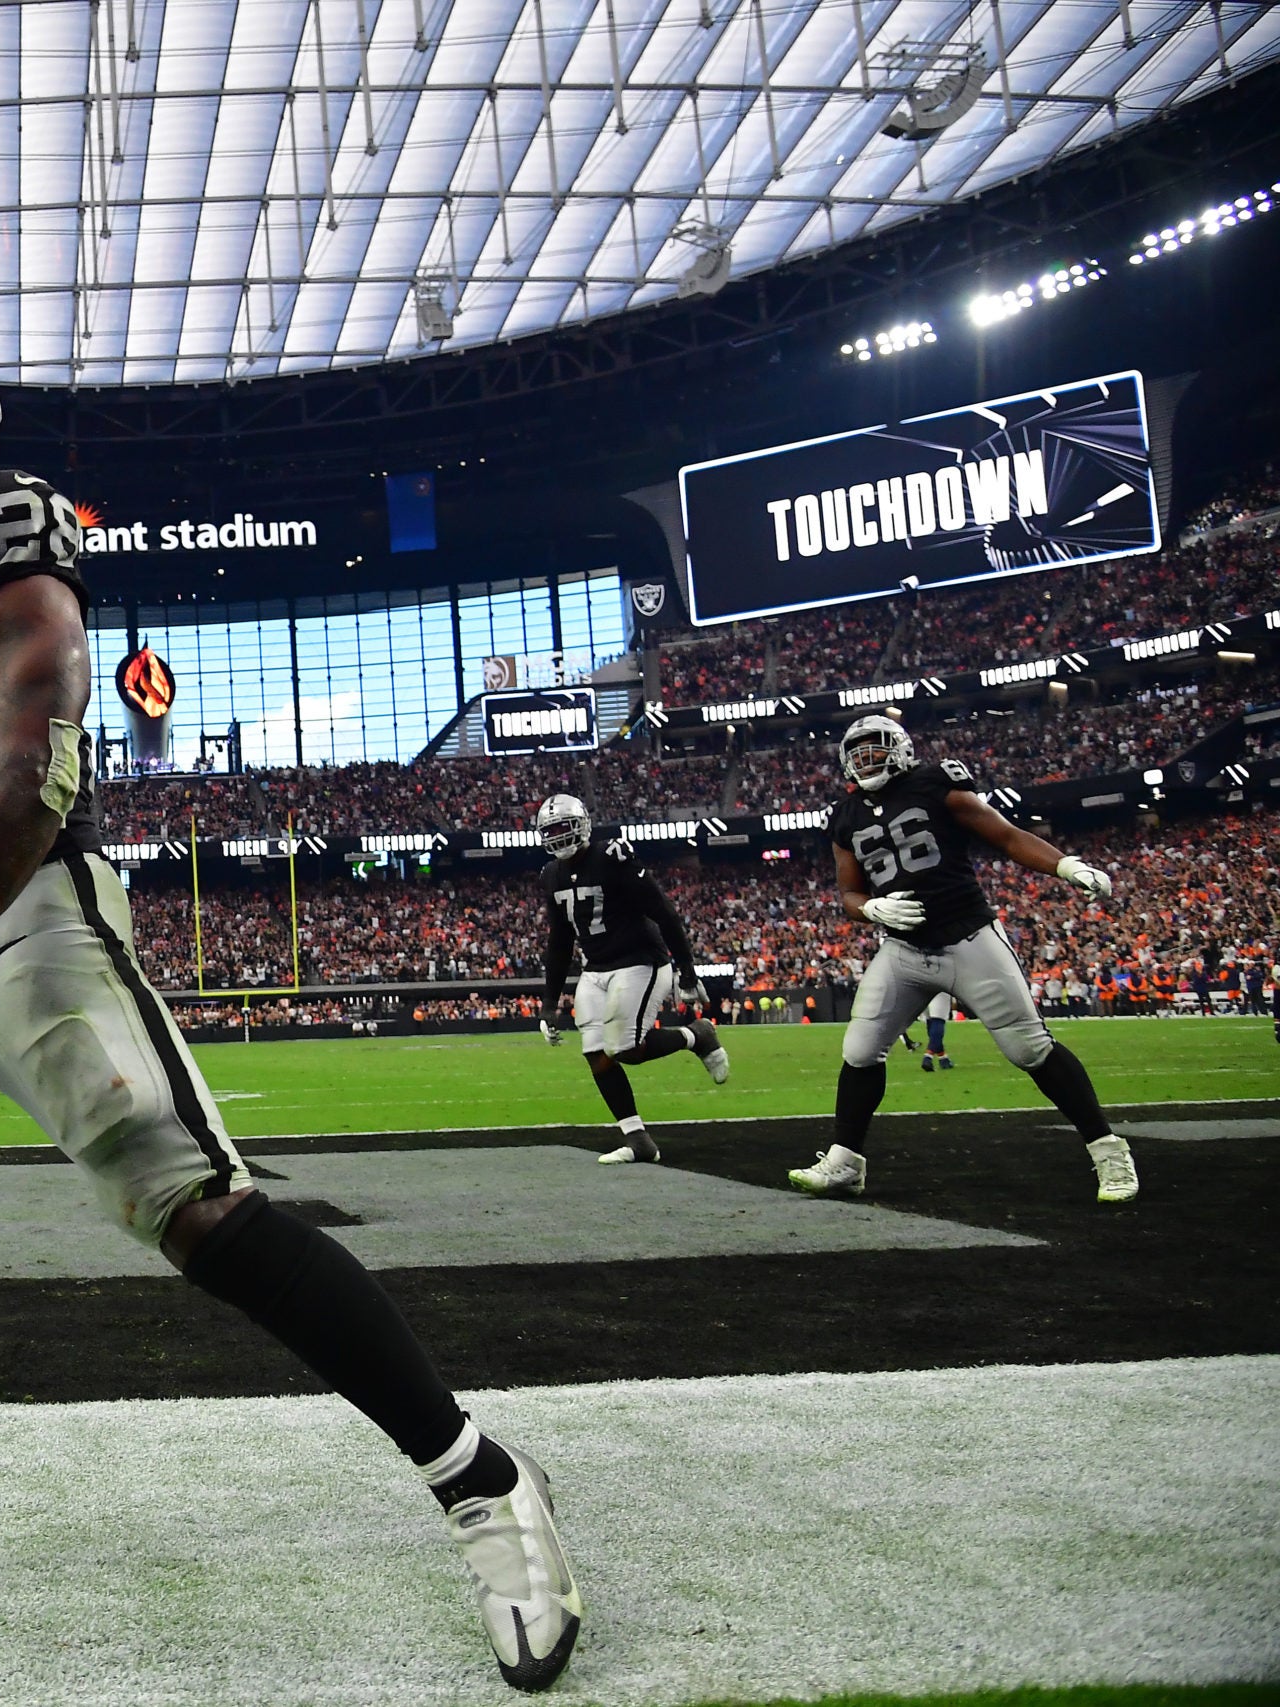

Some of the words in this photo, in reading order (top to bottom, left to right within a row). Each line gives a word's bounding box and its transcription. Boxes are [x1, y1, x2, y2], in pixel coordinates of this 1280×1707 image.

[768, 449, 1048, 562] TOUCHDOWN
[161, 513, 317, 550] stadium
[492, 708, 588, 738] TOUCHDOWN
[852, 808, 941, 887] 66
[553, 885, 607, 936] 77
